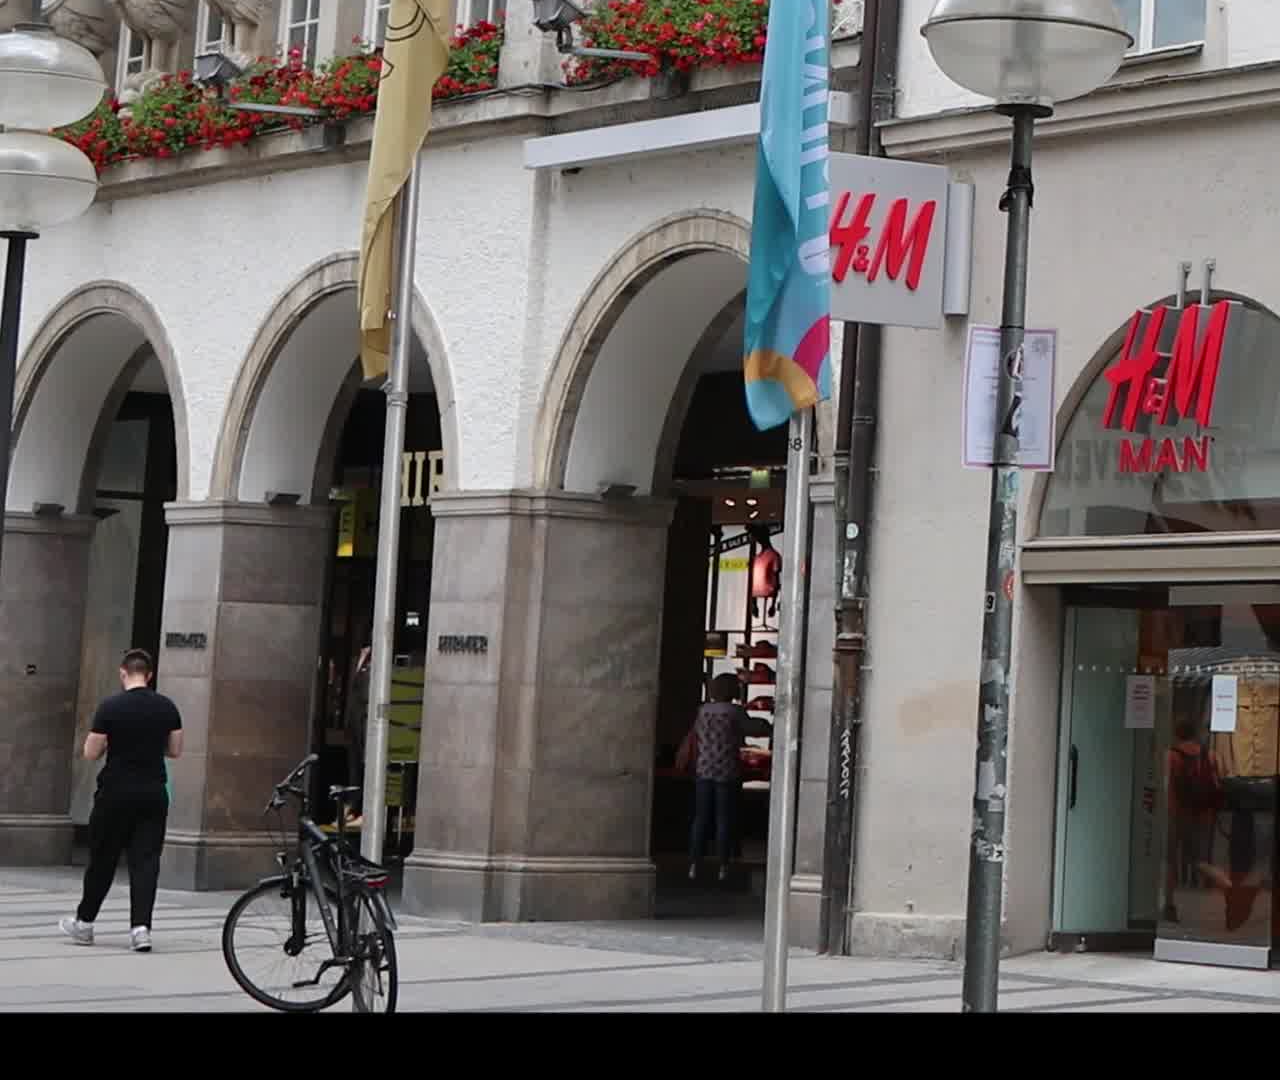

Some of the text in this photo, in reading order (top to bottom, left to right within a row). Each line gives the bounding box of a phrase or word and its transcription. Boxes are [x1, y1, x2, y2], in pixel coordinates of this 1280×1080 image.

[828, 191, 937, 291] H&M
[1102, 299, 1233, 432] H&M
[1117, 438, 1211, 474] MAN
